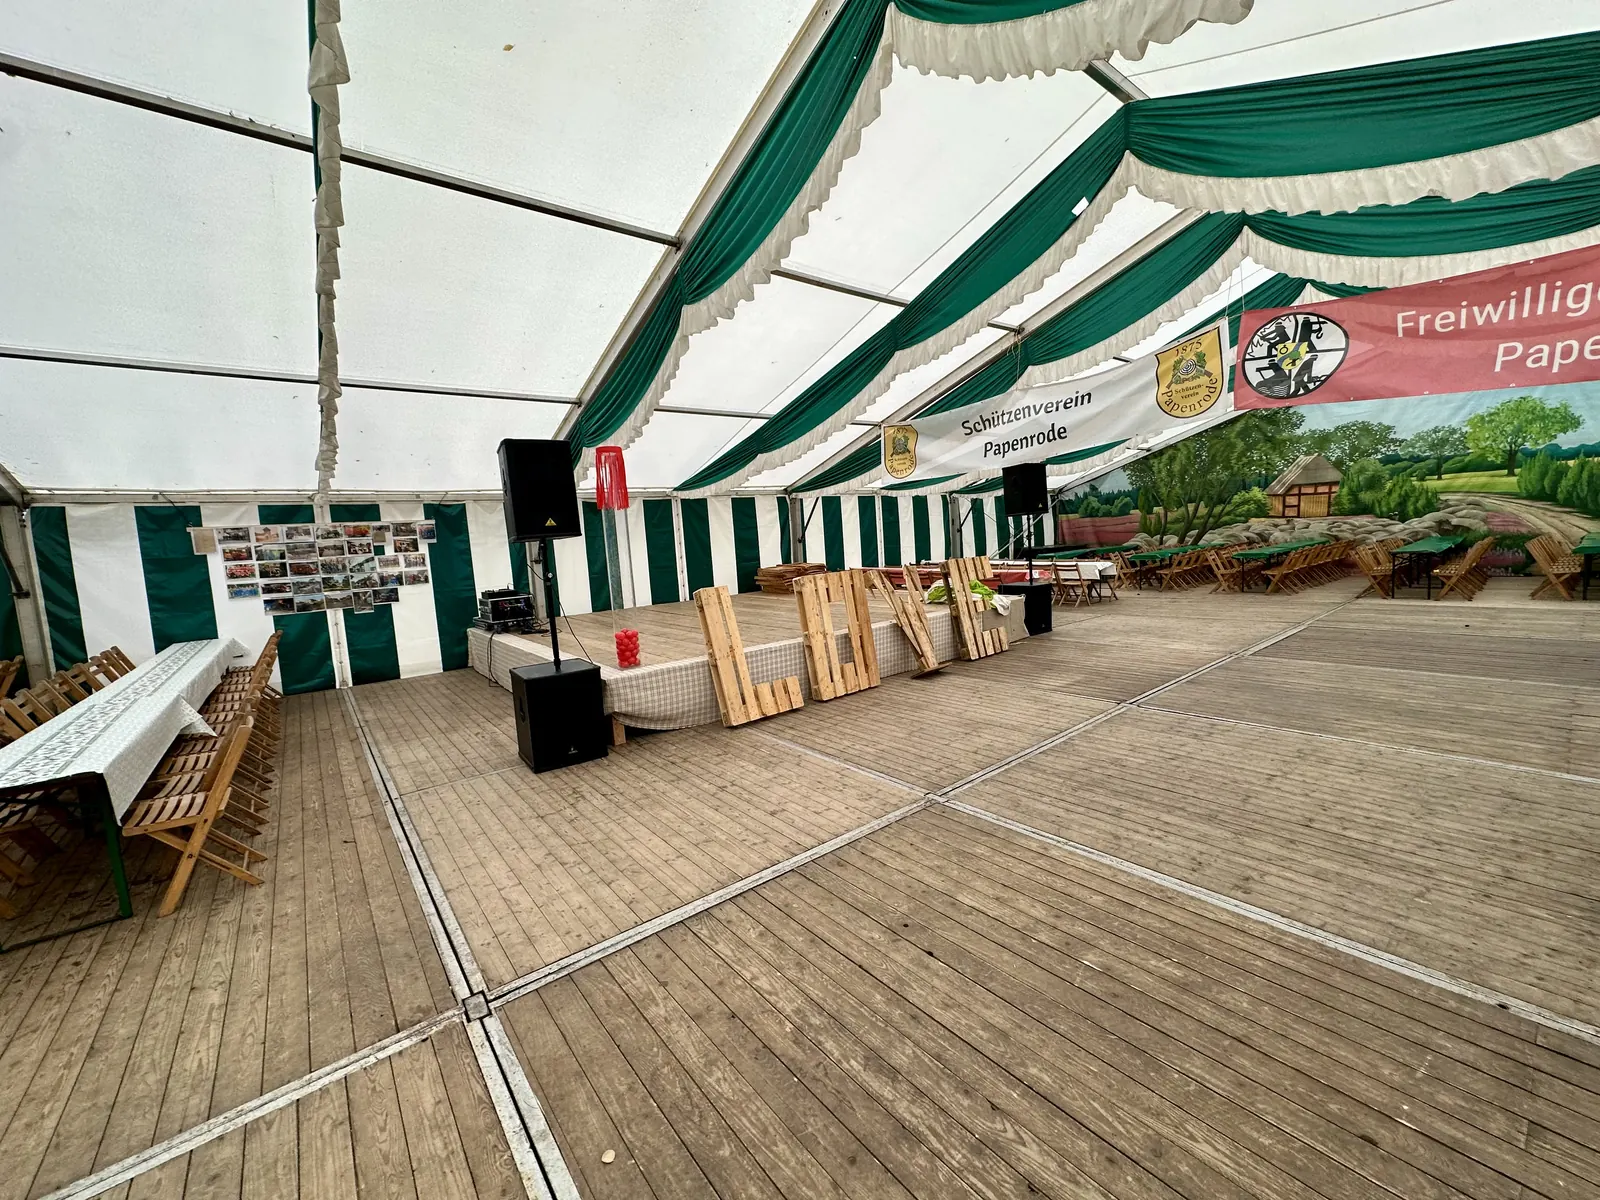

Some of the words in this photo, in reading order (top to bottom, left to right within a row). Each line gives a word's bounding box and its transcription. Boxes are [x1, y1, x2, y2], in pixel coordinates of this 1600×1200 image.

[1396, 280, 1600, 338] Freiwillig
[1175, 338, 1203, 357] 1875
[1161, 377, 1218, 413] Papenrode
[1174, 383, 1204, 395] Schützen-
[1181, 390, 1199, 399] verein
[961, 389, 1093, 436] Schützenverein
[983, 423, 1068, 458] Papenrode
